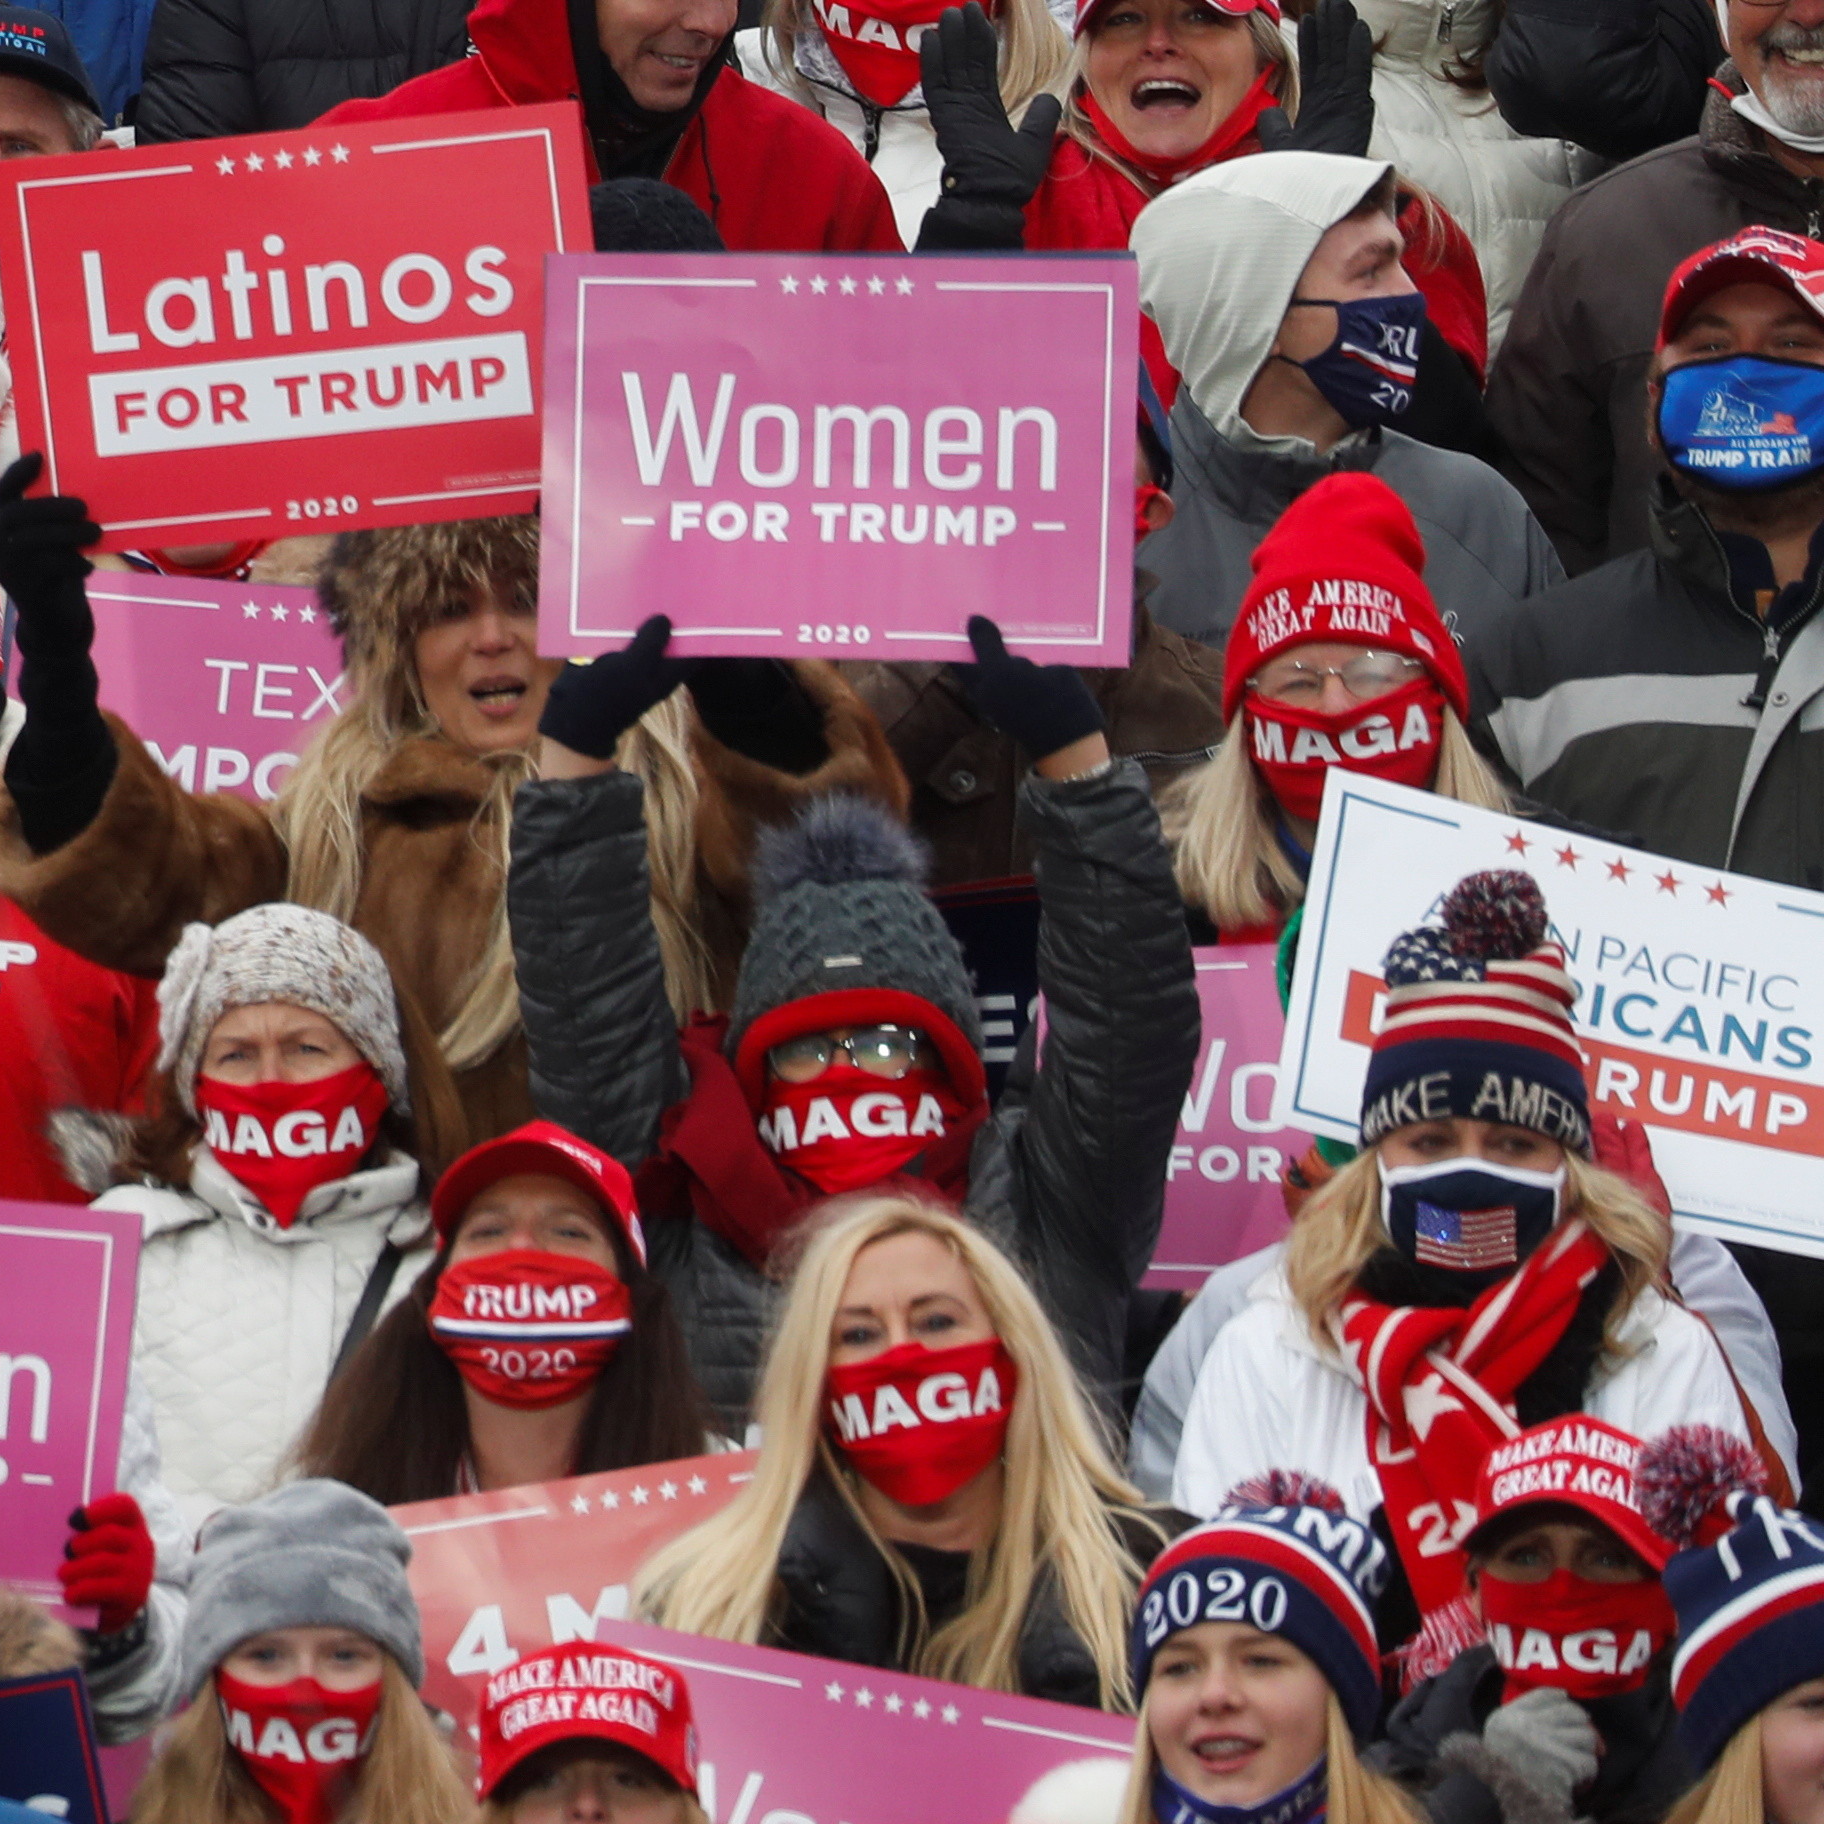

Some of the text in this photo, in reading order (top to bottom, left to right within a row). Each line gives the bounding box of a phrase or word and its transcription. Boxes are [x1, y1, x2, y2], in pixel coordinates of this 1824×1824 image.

[80, 234, 513, 354] Latinos
[115, 353, 508, 434] FOR TRUMP
[621, 370, 1059, 491] Women
[1689, 444, 1811, 468] TRUMP TRAIN
[285, 495, 360, 520] 2020
[669, 501, 1018, 546] FOR TRUMP
[1247, 578, 1407, 636] MAKE AMERICA
[1256, 606, 1392, 650] GREAT AGAIN
[797, 624, 871, 645] 2020
[1254, 705, 1431, 766] MAGA
[1601, 936, 1801, 1010] PACIFIC
[1167, 1145, 1281, 1182] FOR
[463, 1283, 597, 1321] TRUMP
[482, 1347, 576, 1381] 2020
[1143, 1568, 1288, 1648] 2020
